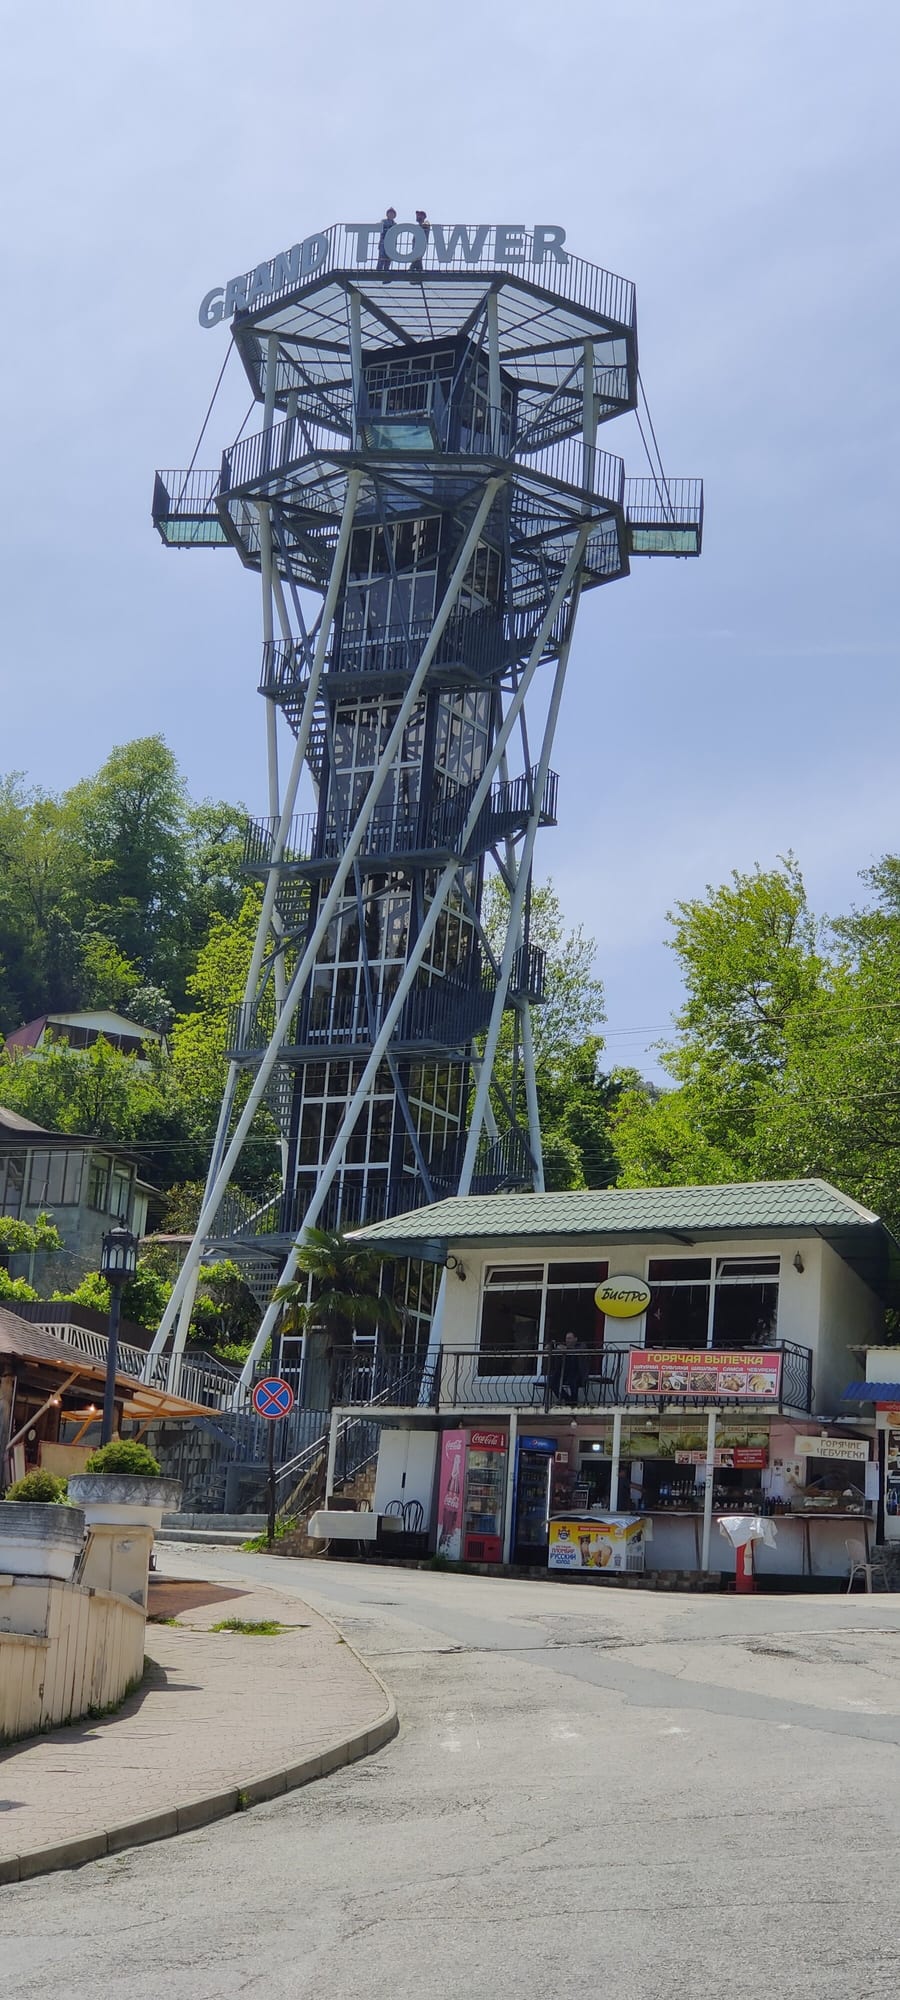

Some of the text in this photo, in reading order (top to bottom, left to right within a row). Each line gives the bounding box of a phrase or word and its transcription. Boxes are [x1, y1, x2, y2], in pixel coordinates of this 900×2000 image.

[198, 223, 570, 329] GRAND TOWER
[601, 1287, 648, 1302] БИСТРО
[647, 1353, 764, 1365] ГОРЯЧАЯ ВЫПЕЧКА
[472, 1433, 499, 1445] Coca-Cola
[820, 1439, 862, 1449] ГОРЯЧИЕ
[817, 1448, 865, 1459] ЧЕБУРЕКИ
